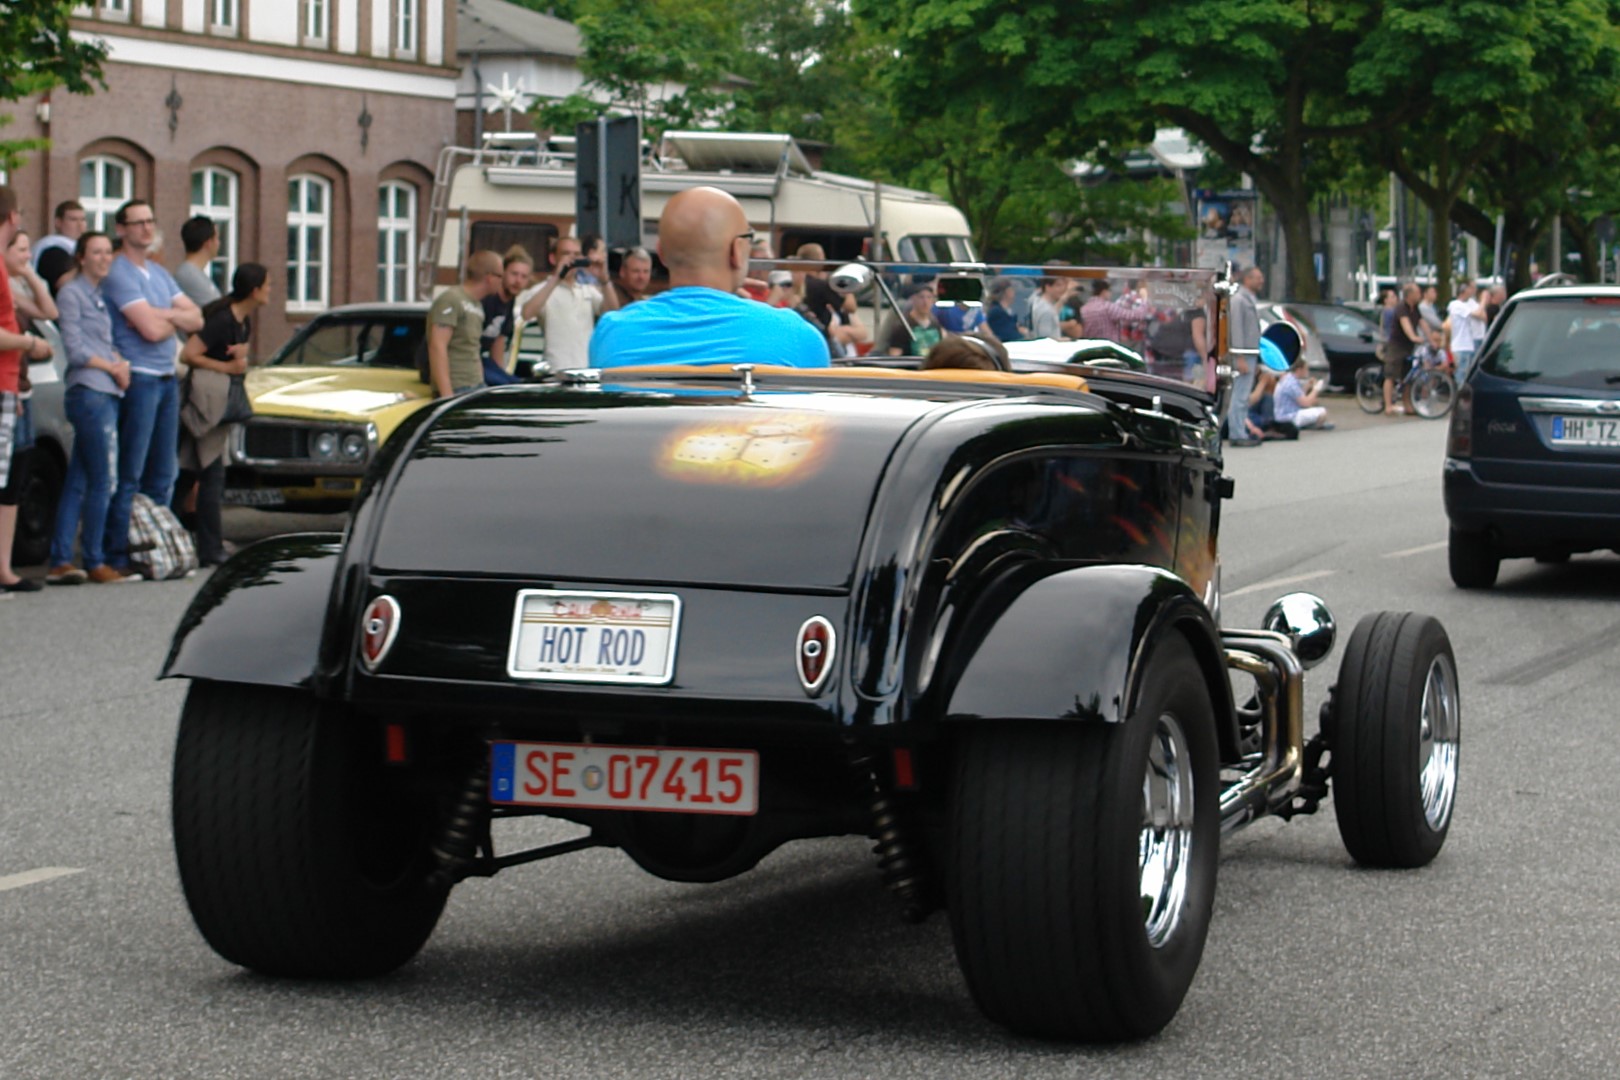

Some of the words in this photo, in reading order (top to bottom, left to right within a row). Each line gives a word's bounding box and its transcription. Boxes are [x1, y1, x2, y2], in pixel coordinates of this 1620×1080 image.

[1563, 420, 1584, 438] HH
[1597, 421, 1617, 439] TZ
[539, 626, 587, 664] HOT
[597, 628, 645, 666] ROD
[524, 750, 576, 797] SE
[608, 754, 744, 804] 07415
